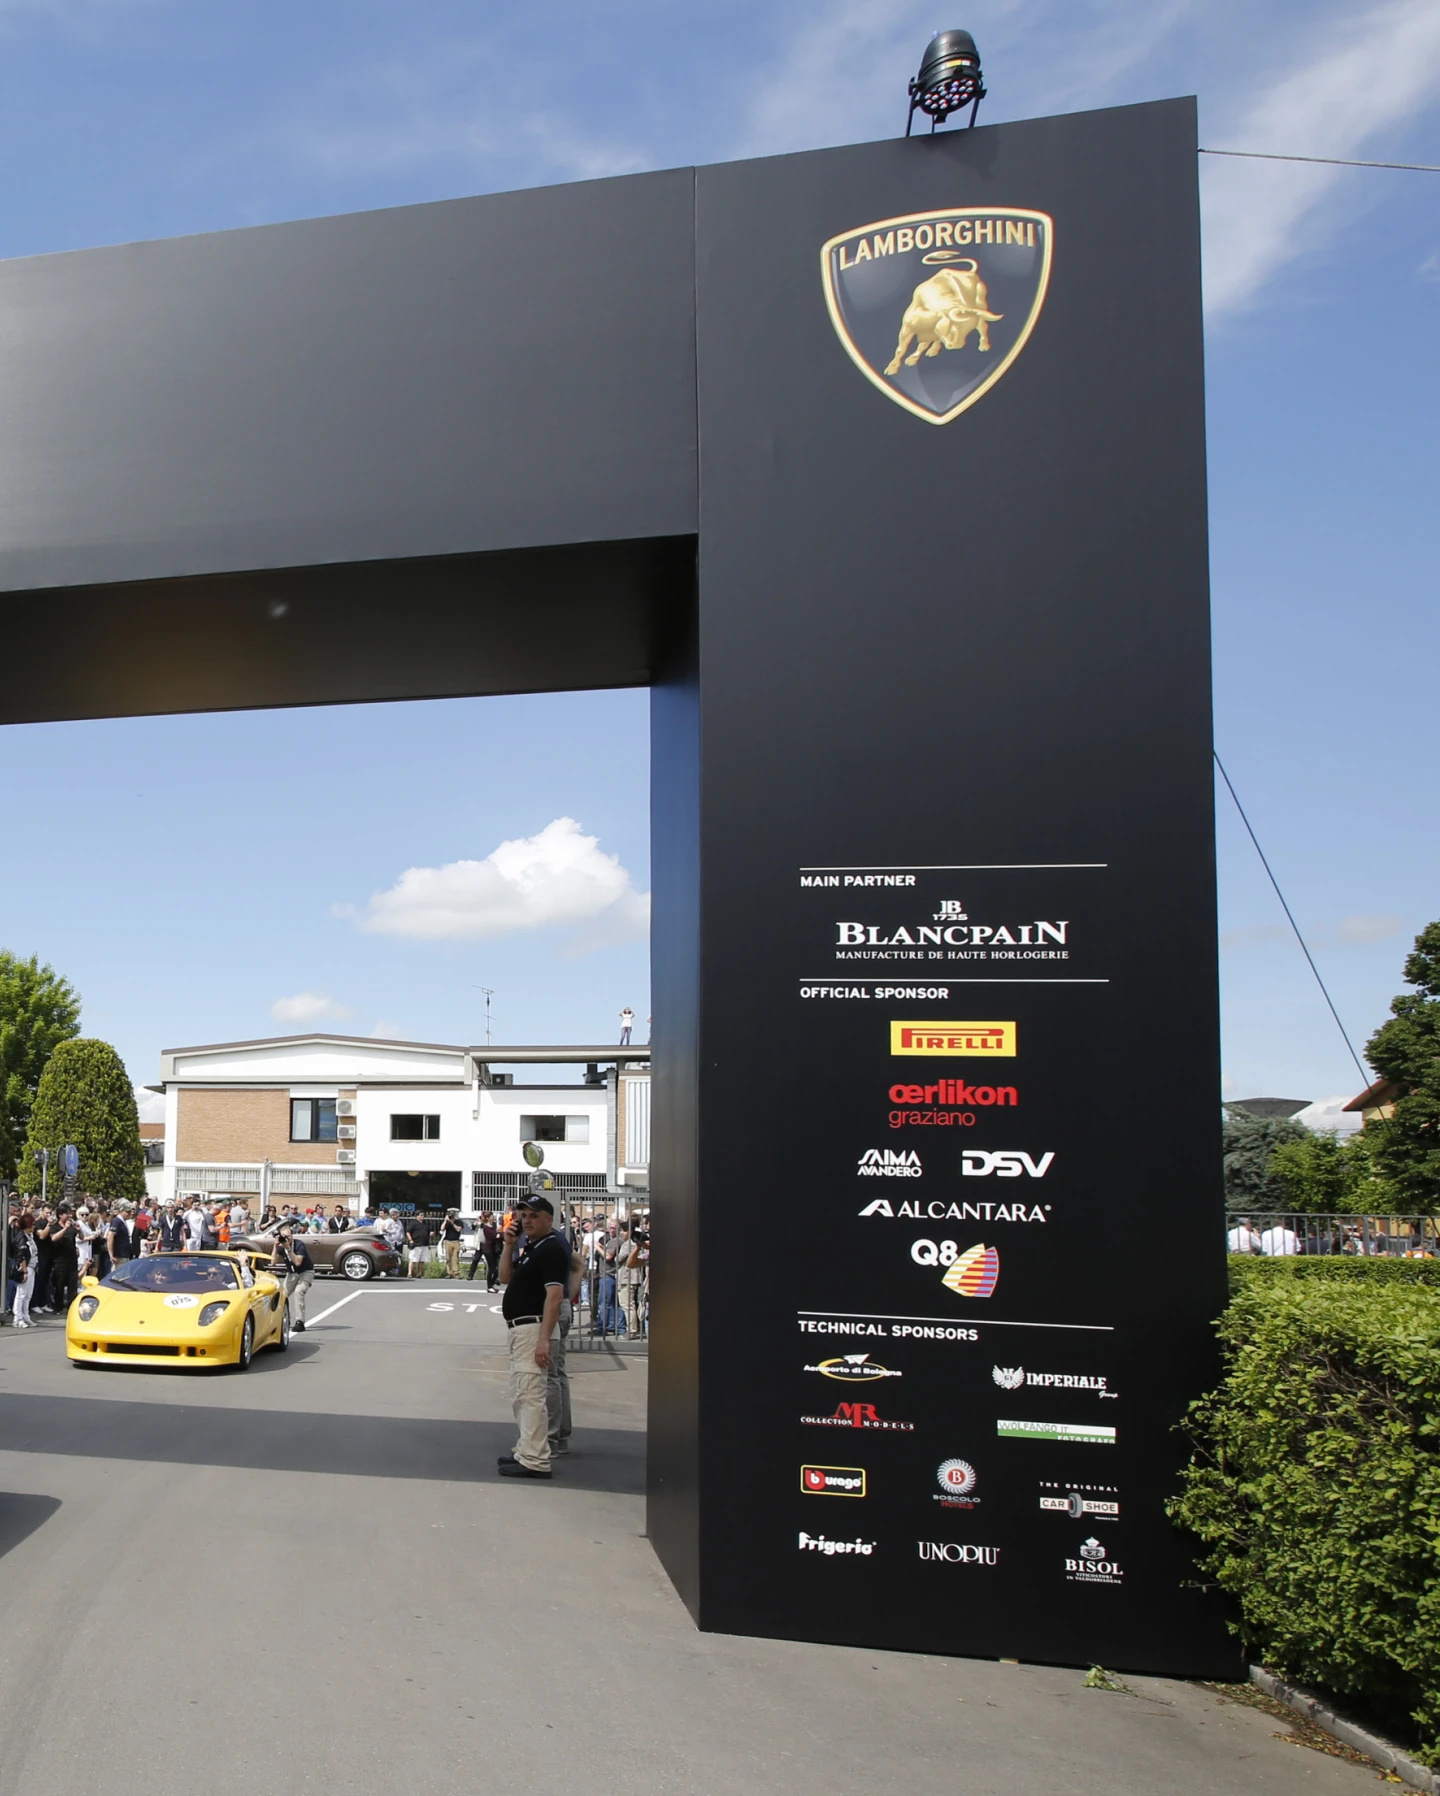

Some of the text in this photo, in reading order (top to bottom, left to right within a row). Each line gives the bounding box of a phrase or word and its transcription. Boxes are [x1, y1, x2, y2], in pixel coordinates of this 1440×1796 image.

[839, 220, 1035, 271] LAMBORGHINI
[801, 875, 916, 887] MAIN PARTNER
[836, 921, 1069, 945] BLANCPAIN
[836, 951, 1069, 960] MANUFACTURE DE HAUTE HORLOGERIE
[800, 987, 949, 999] OFFICIAL SPONSOR
[901, 1028, 1005, 1049] PIRELLI
[888, 1108, 975, 1129] graziano
[858, 1149, 921, 1166] SAIMA
[962, 1150, 1055, 1178] DSV
[857, 1166, 922, 1177] AVANDERO
[910, 1238, 958, 1267] Q8
[798, 1320, 978, 1341] TECHNICAL SPONSORS
[803, 1364, 903, 1377] Aeroporto di Bologna
[1026, 1372, 1107, 1389] IMPERIALE
[800, 1416, 852, 1426] COLLECTION
[1065, 1483, 1118, 1492] ORIGINAL
[933, 1495, 981, 1503] BOSCOLO
[1042, 1499, 1116, 1512] CAR SHOE
[799, 1532, 873, 1555] Frigerio
[1065, 1559, 1123, 1575] BISOL
